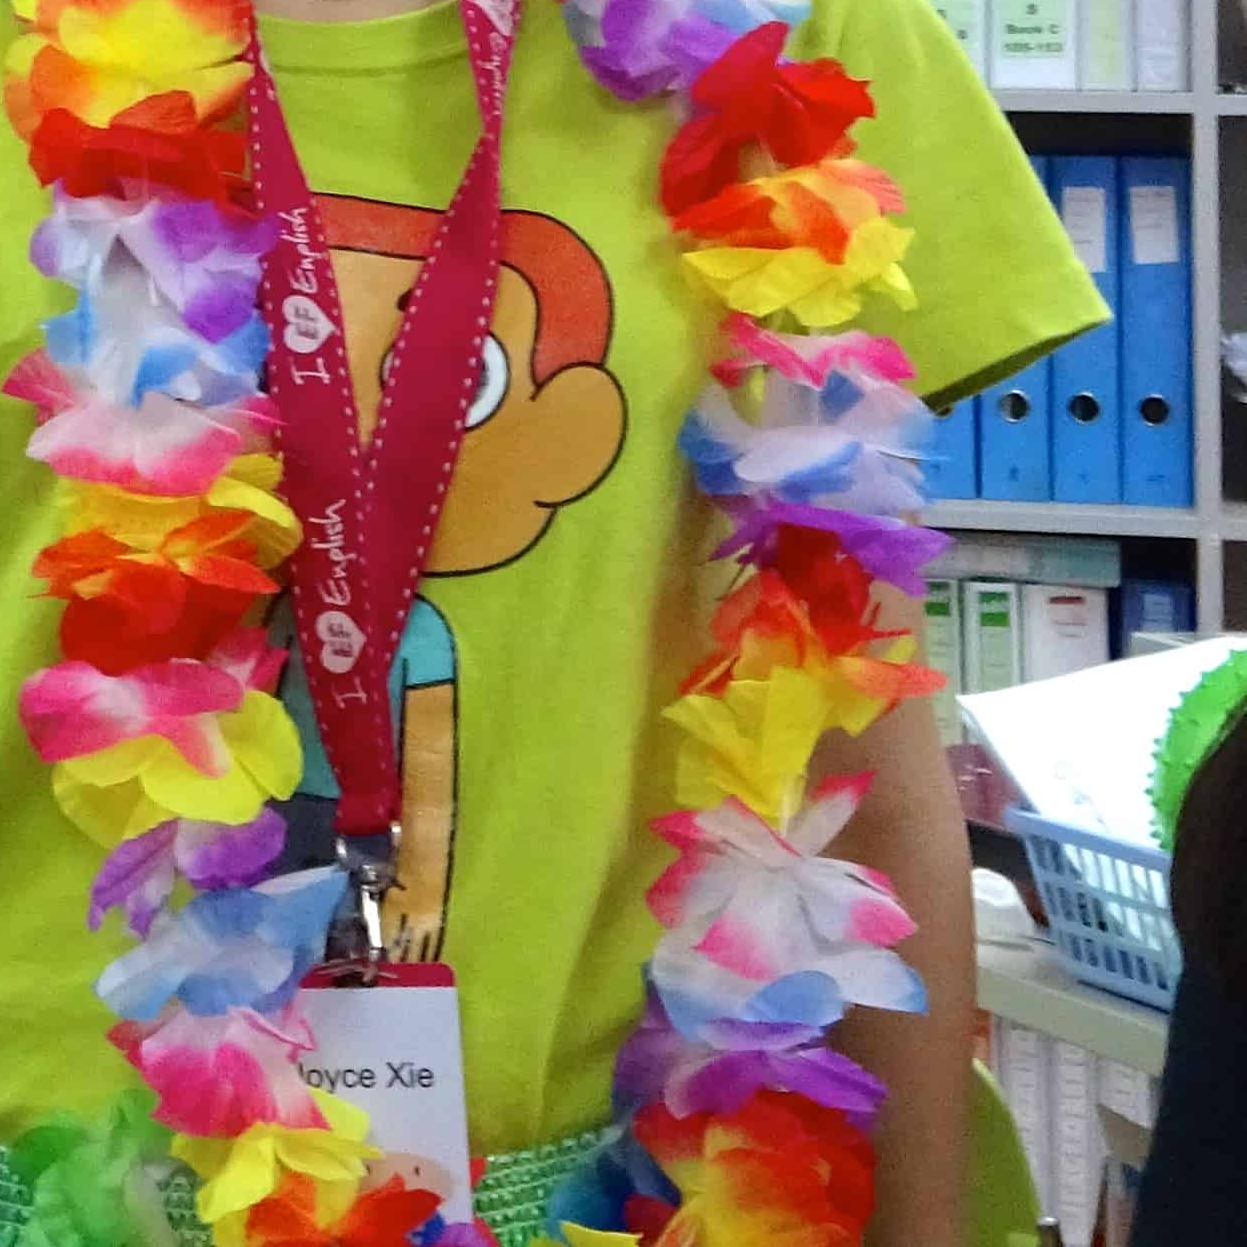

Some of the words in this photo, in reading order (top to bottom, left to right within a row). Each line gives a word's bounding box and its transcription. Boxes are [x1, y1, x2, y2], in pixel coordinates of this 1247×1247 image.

[279, 207, 325, 294] English
[293, 305, 319, 341] EF
[288, 356, 332, 385] I
[307, 498, 358, 606] English
[330, 676, 368, 709] I
[386, 1061, 435, 1088] Xie
